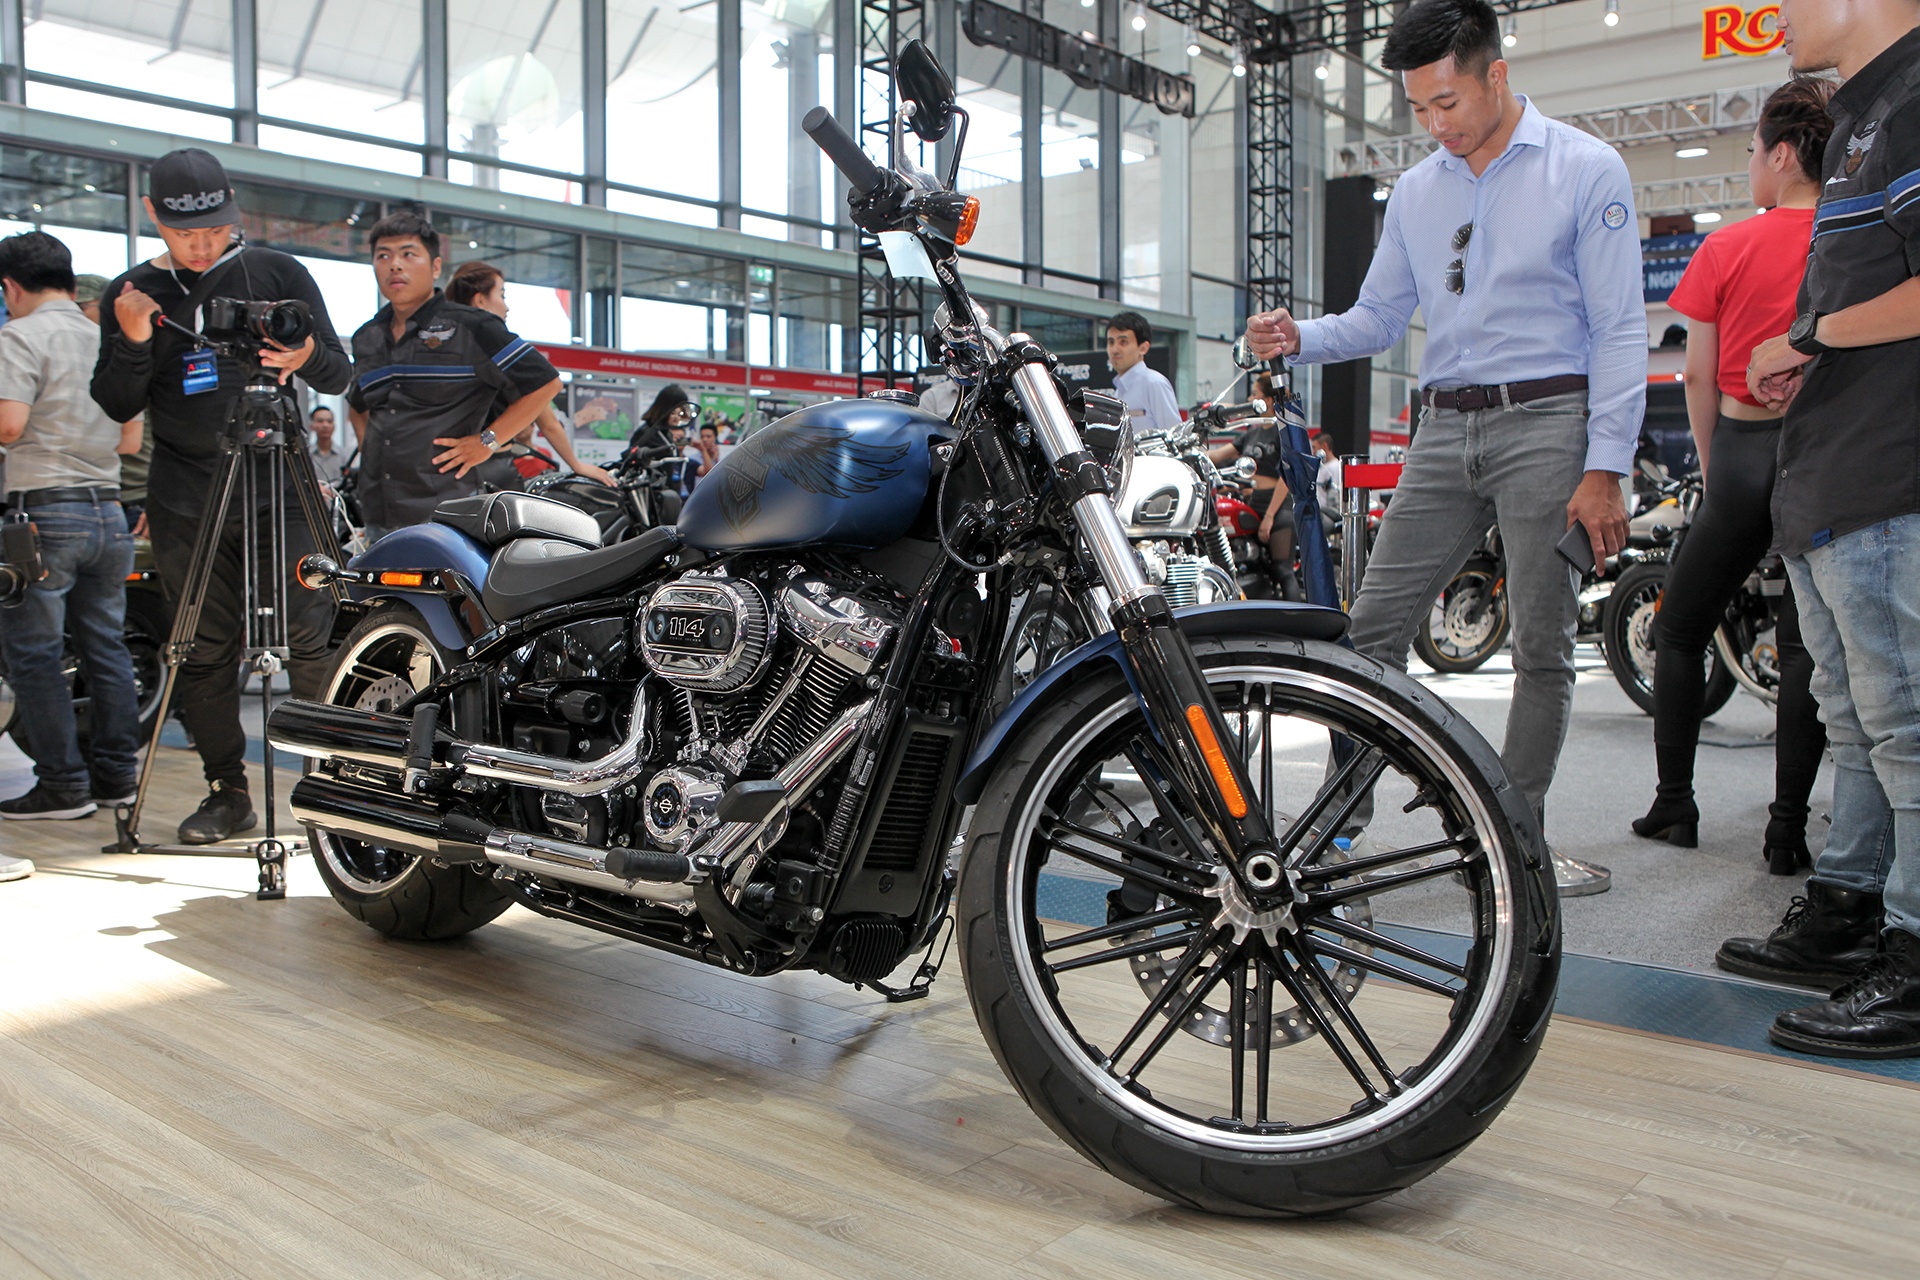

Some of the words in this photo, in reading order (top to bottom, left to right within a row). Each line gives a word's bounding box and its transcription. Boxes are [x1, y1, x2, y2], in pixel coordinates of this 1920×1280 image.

[163, 189, 225, 212] adidas
[626, 360, 650, 370] BRAKE
[651, 362, 689, 374] INDUSTRIAL
[669, 616, 706, 638] 114
